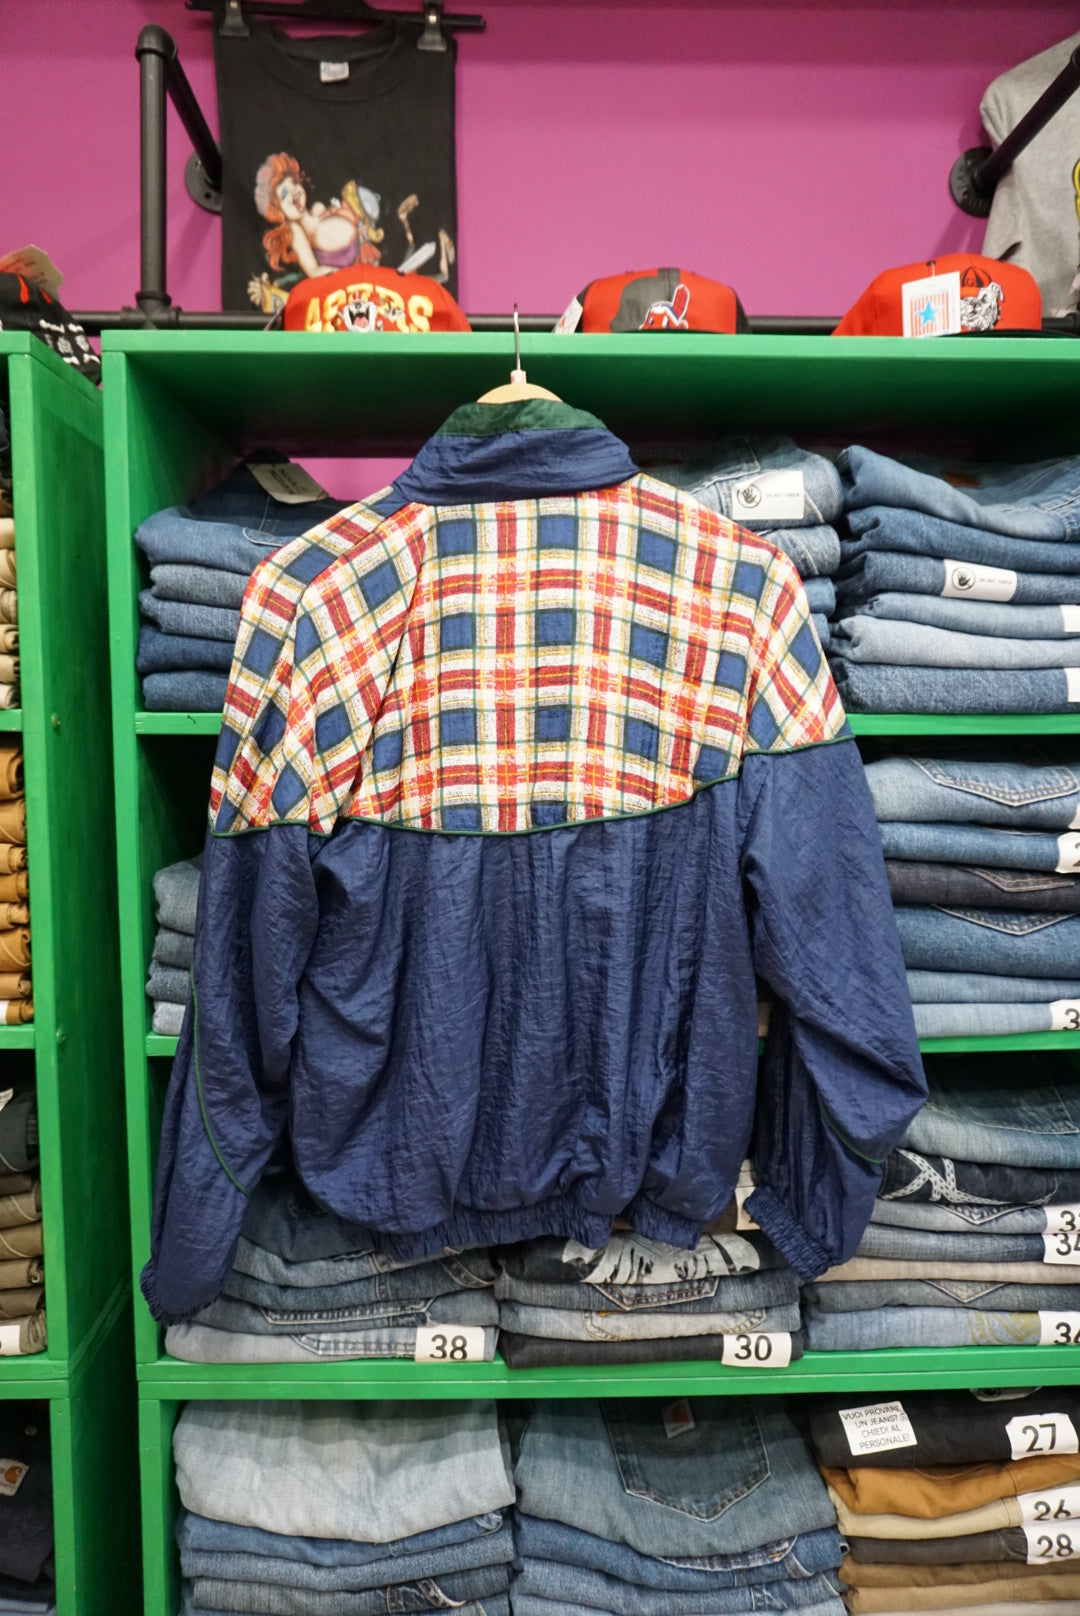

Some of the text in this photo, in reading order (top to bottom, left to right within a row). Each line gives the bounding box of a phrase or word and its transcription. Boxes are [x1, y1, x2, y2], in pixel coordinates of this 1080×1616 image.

[1058, 1210, 1080, 1232] 3
[430, 1334, 468, 1360] 38
[734, 1334, 772, 1361] 30
[842, 1405, 900, 1420] VUOI PROVARE
[855, 1414, 898, 1428] UN JEANS?
[859, 1433, 910, 1449] PERSONALE!
[861, 1424, 901, 1438] CHIEDI AL
[1022, 1422, 1056, 1452] 27
[1033, 1499, 1072, 1521] 26
[1037, 1533, 1074, 1557] 28
